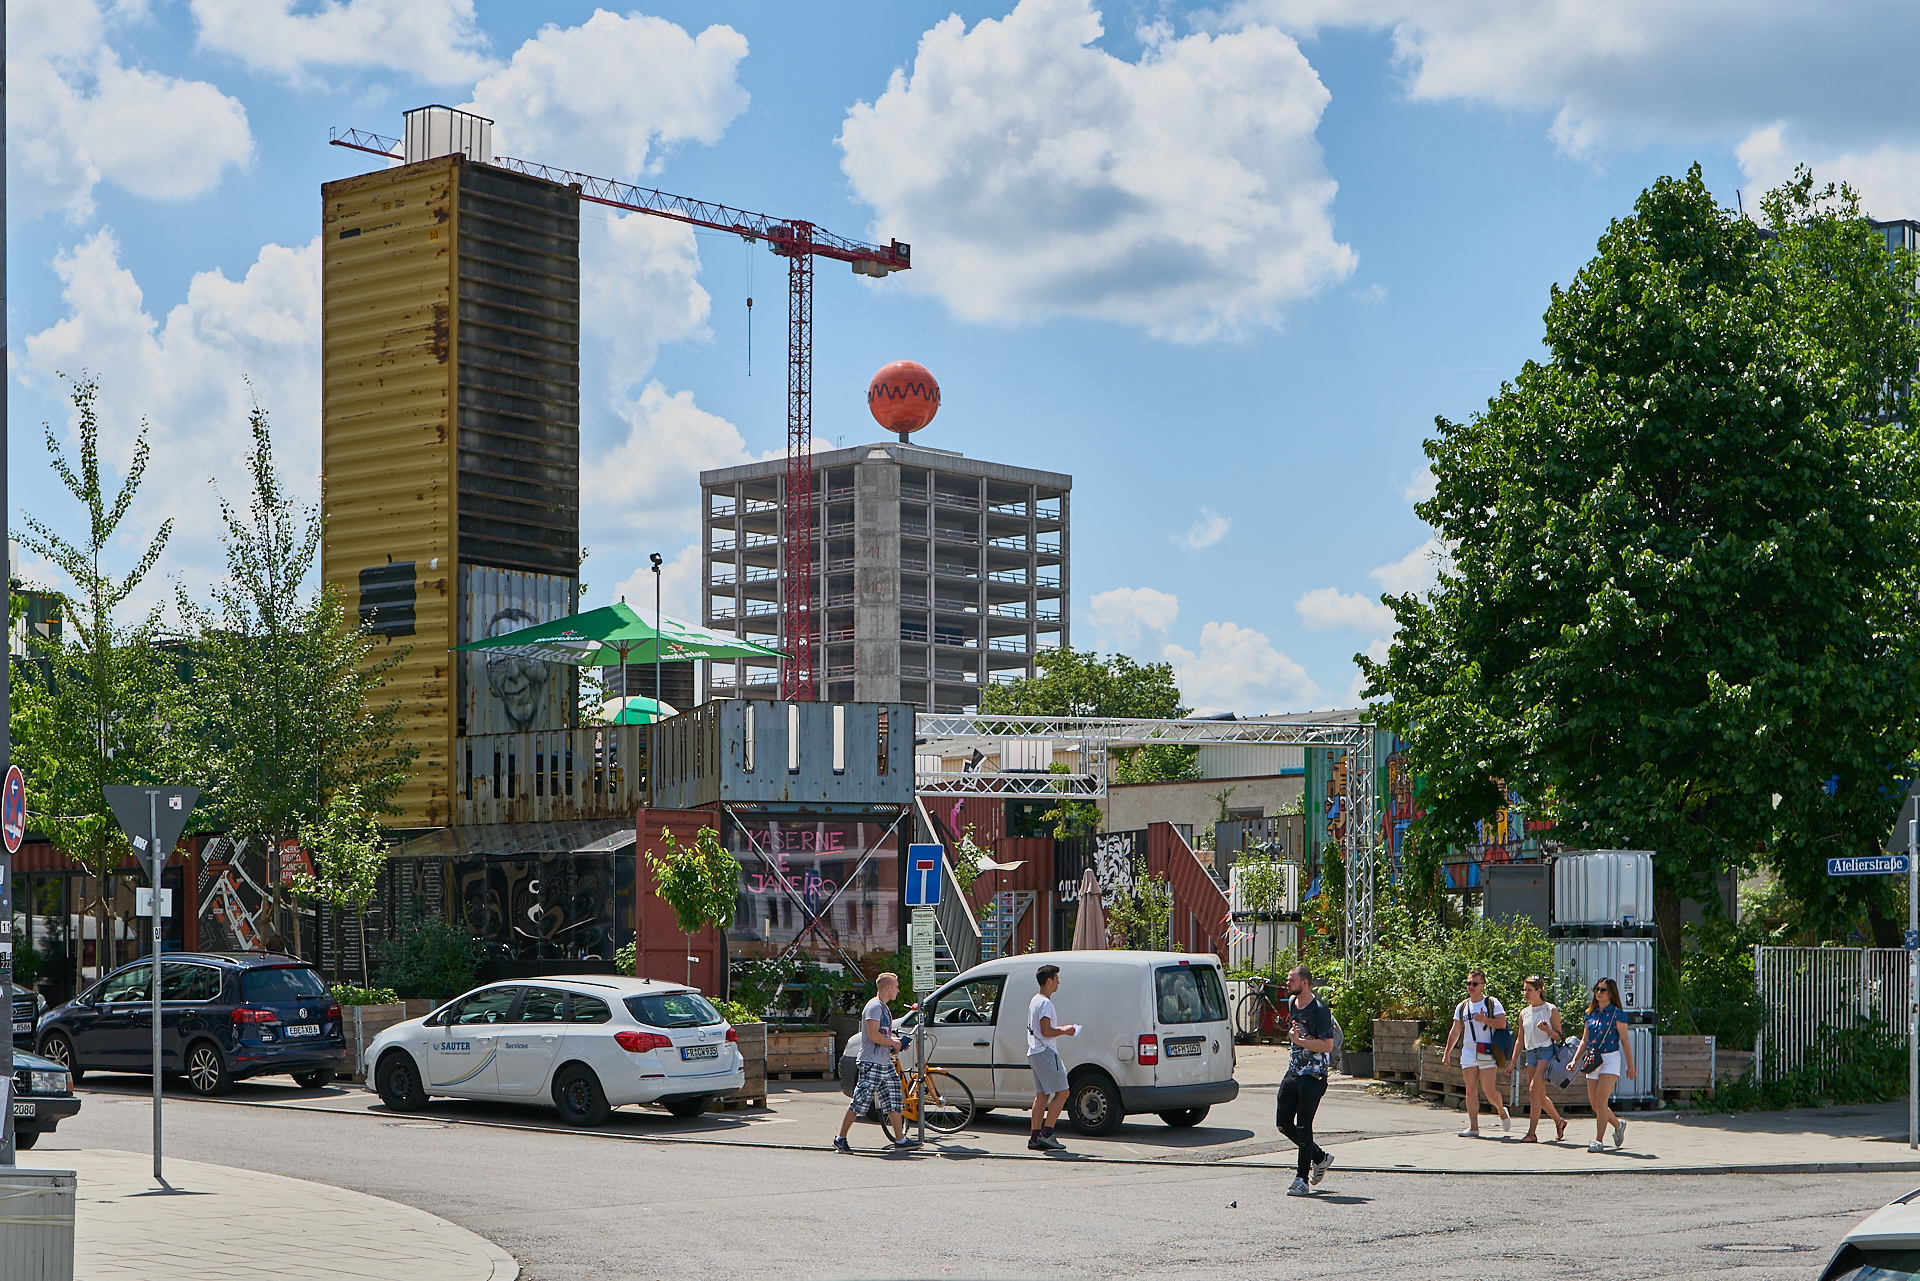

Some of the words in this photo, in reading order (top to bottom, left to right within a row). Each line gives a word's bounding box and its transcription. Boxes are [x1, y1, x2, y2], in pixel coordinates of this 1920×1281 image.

[868, 581, 883, 594] 10
[747, 829, 844, 851] KASERNE
[1833, 857, 1903, 872] Atelierstraße
[441, 1042, 471, 1050] SAUTER
[686, 1047, 694, 1057] FR
[706, 1046, 716, 1055] 935
[14, 1104, 35, 1115] 2080
